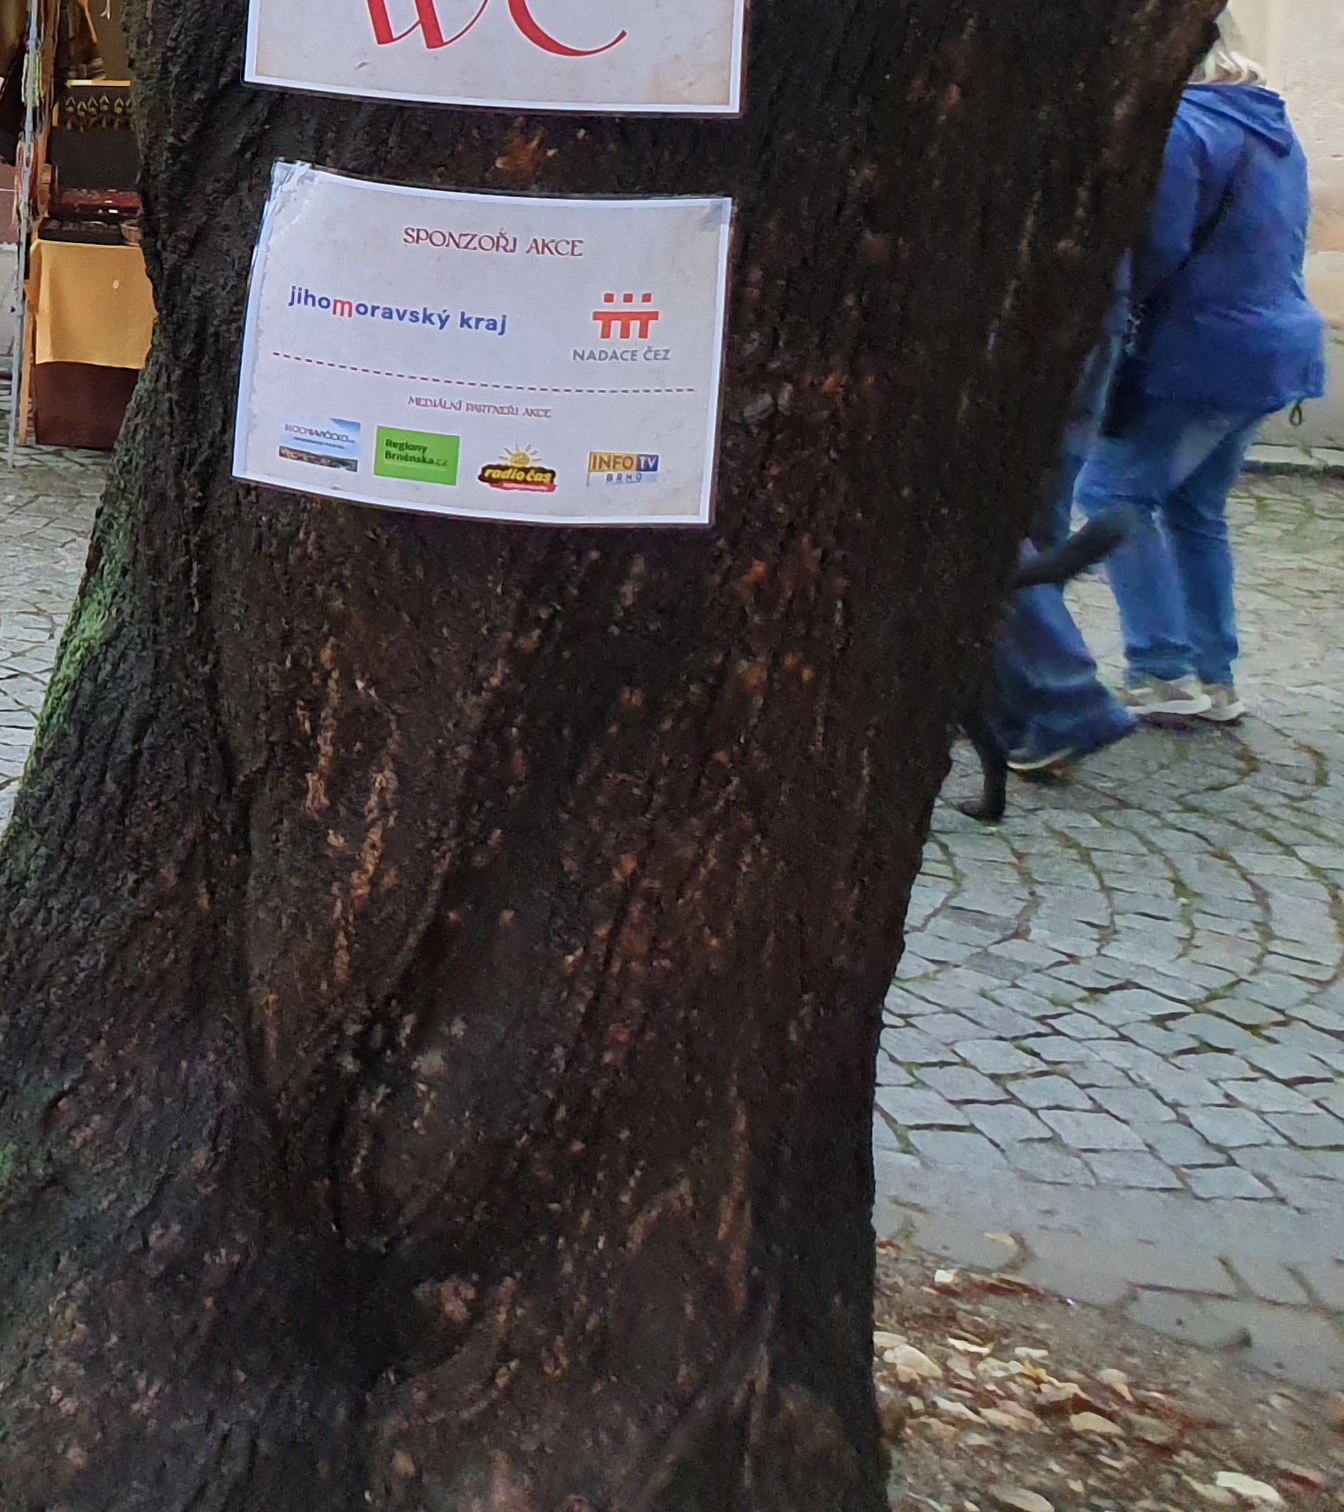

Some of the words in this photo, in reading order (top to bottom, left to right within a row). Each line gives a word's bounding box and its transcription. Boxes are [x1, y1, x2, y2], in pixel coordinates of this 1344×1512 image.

[525, 238, 584, 257] AKCE
[287, 285, 451, 331] jihomoravský
[459, 309, 508, 336] kraj
[571, 348, 638, 362] NADACE
[642, 346, 672, 362] ČEZ
[384, 438, 428, 454] Regiony
[591, 454, 636, 471] INFO
[638, 455, 658, 471] TV
[484, 466, 525, 482] radio
